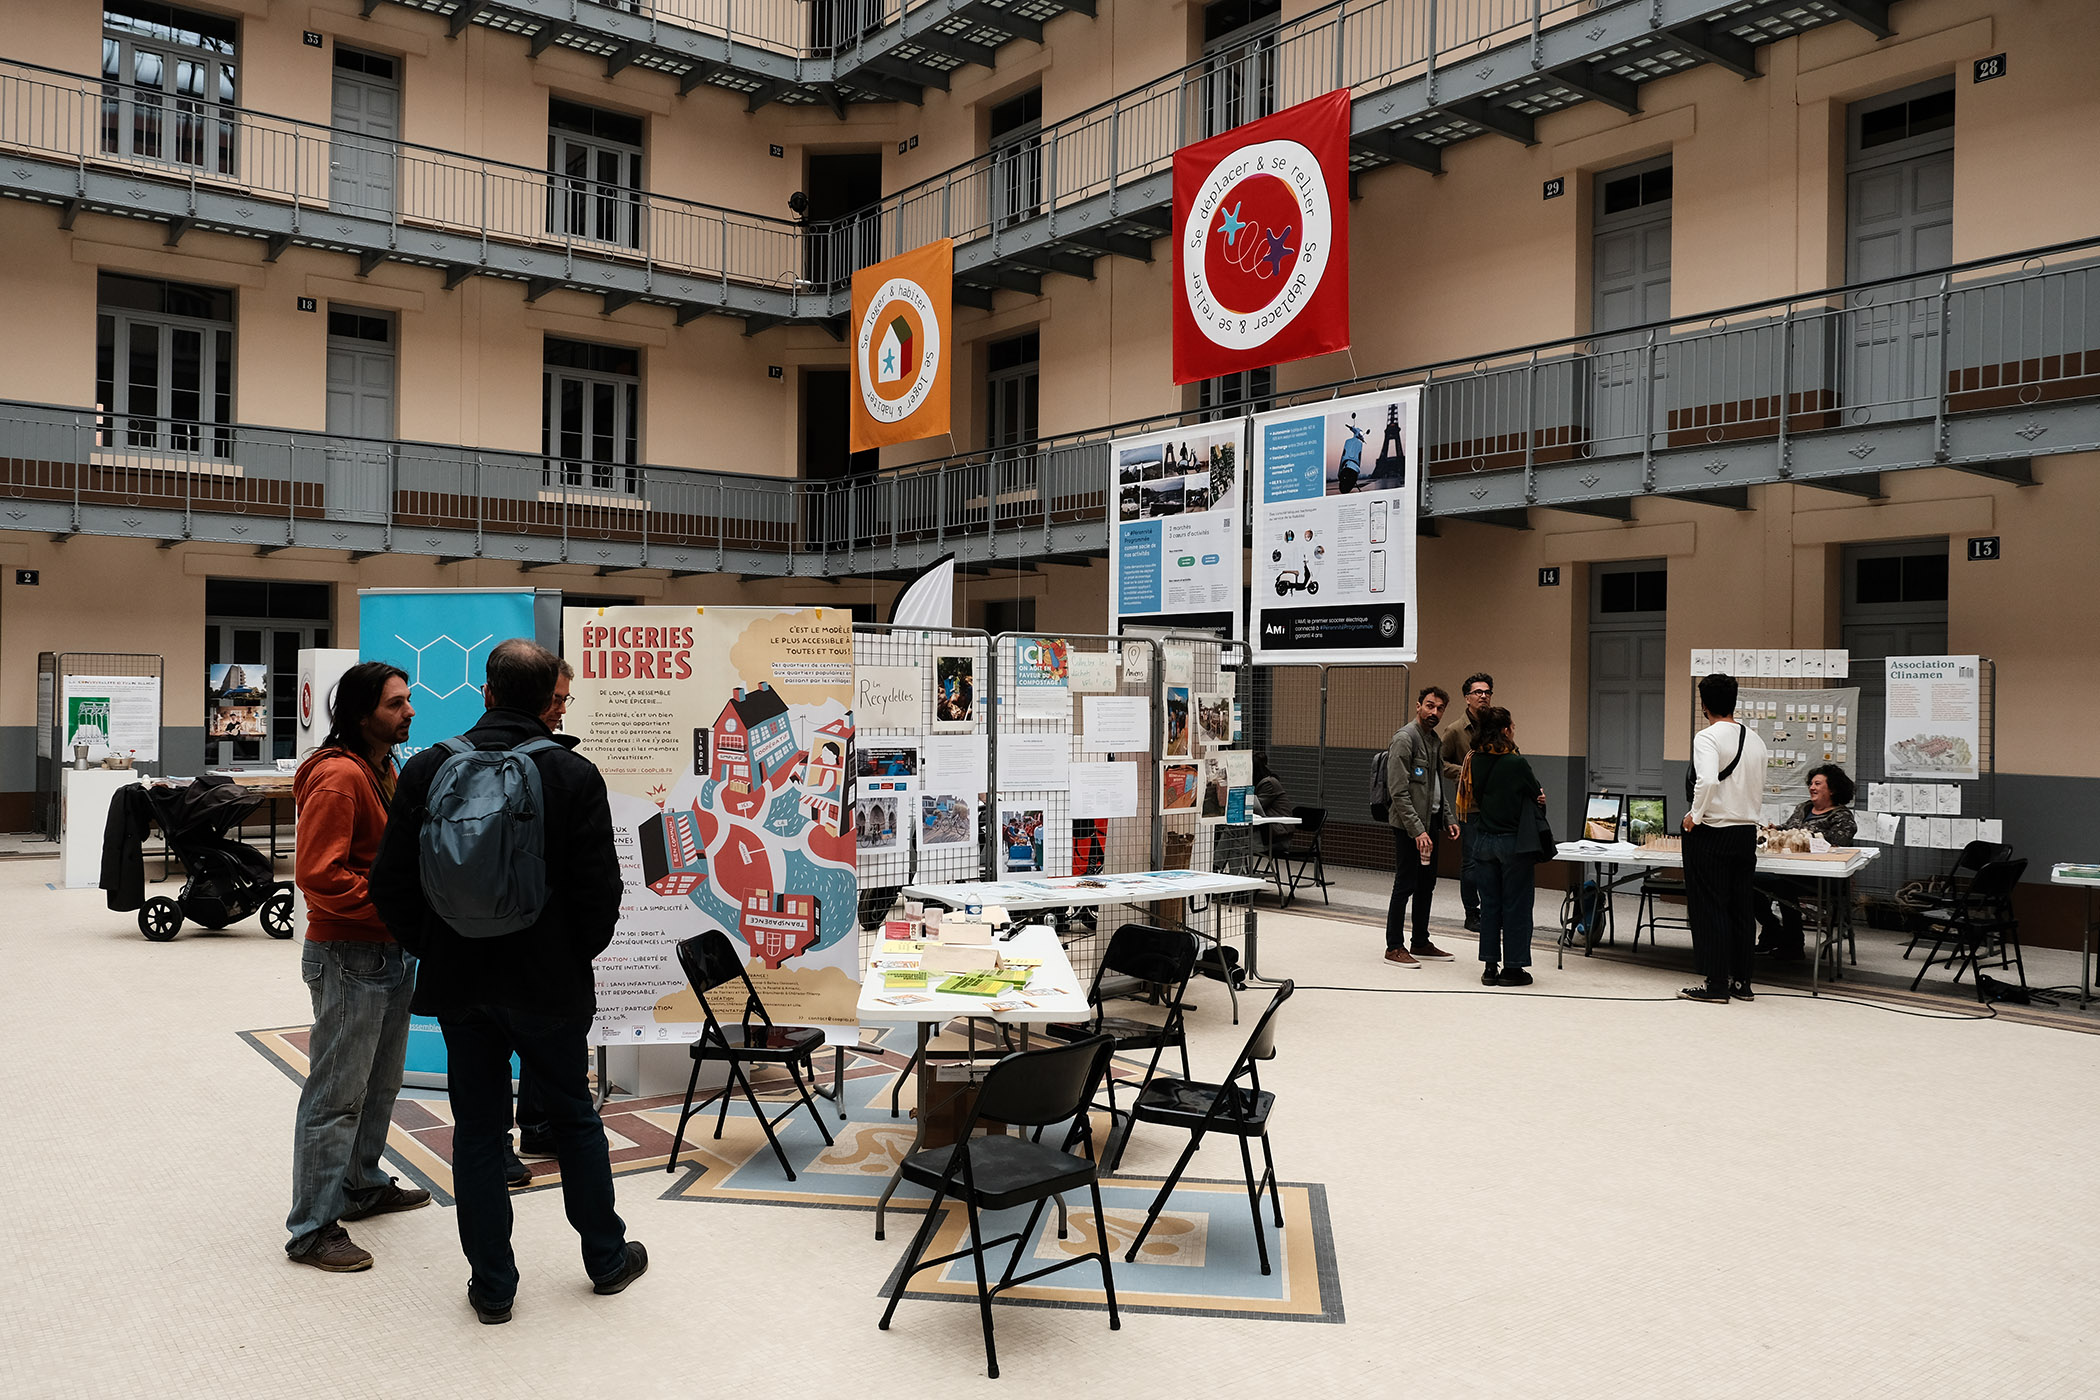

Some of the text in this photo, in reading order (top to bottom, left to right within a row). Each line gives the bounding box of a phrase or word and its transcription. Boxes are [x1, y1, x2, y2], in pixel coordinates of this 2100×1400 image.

[307, 33, 319, 45] 33
[1980, 60, 1998, 78] 28
[772, 147, 782, 156] 32
[1546, 182, 1560, 196] 29
[1190, 155, 1315, 249] Se déplacer & se relier
[1192, 242, 1317, 334] Se déplacer & se relier
[302, 299, 313, 310] 18
[861, 283, 927, 349] Se loger & habiter
[866, 351, 935, 418] Se loger & habiter
[1974, 541, 1993, 557] 13
[24, 573, 31, 583] 2
[1543, 571, 1555, 583] 14
[582, 620, 695, 649] ÉPICERIES
[789, 624, 851, 634] C'EST LE MODÈLE
[770, 635, 851, 645] LE PLUS ACCESSIBLE À
[1018, 645, 1043, 665] ICI
[582, 650, 693, 680] LIBRES
[1890, 660, 1956, 670] Association
[1890, 671, 1944, 680] Clinamen
[627, 690, 637, 698] ÇA
[621, 720, 632, 729] qui
[632, 720, 670, 729] appartient
[661, 738, 679, 746] passe
[668, 821, 677, 849] COMMUN
[649, 903, 682, 911] SIMPLICITÉ
[750, 917, 805, 928] TRANSPARENCE
[611, 938, 660, 946] CONSÉQUENCES
[626, 980, 685, 988] INFANTILISATION,
